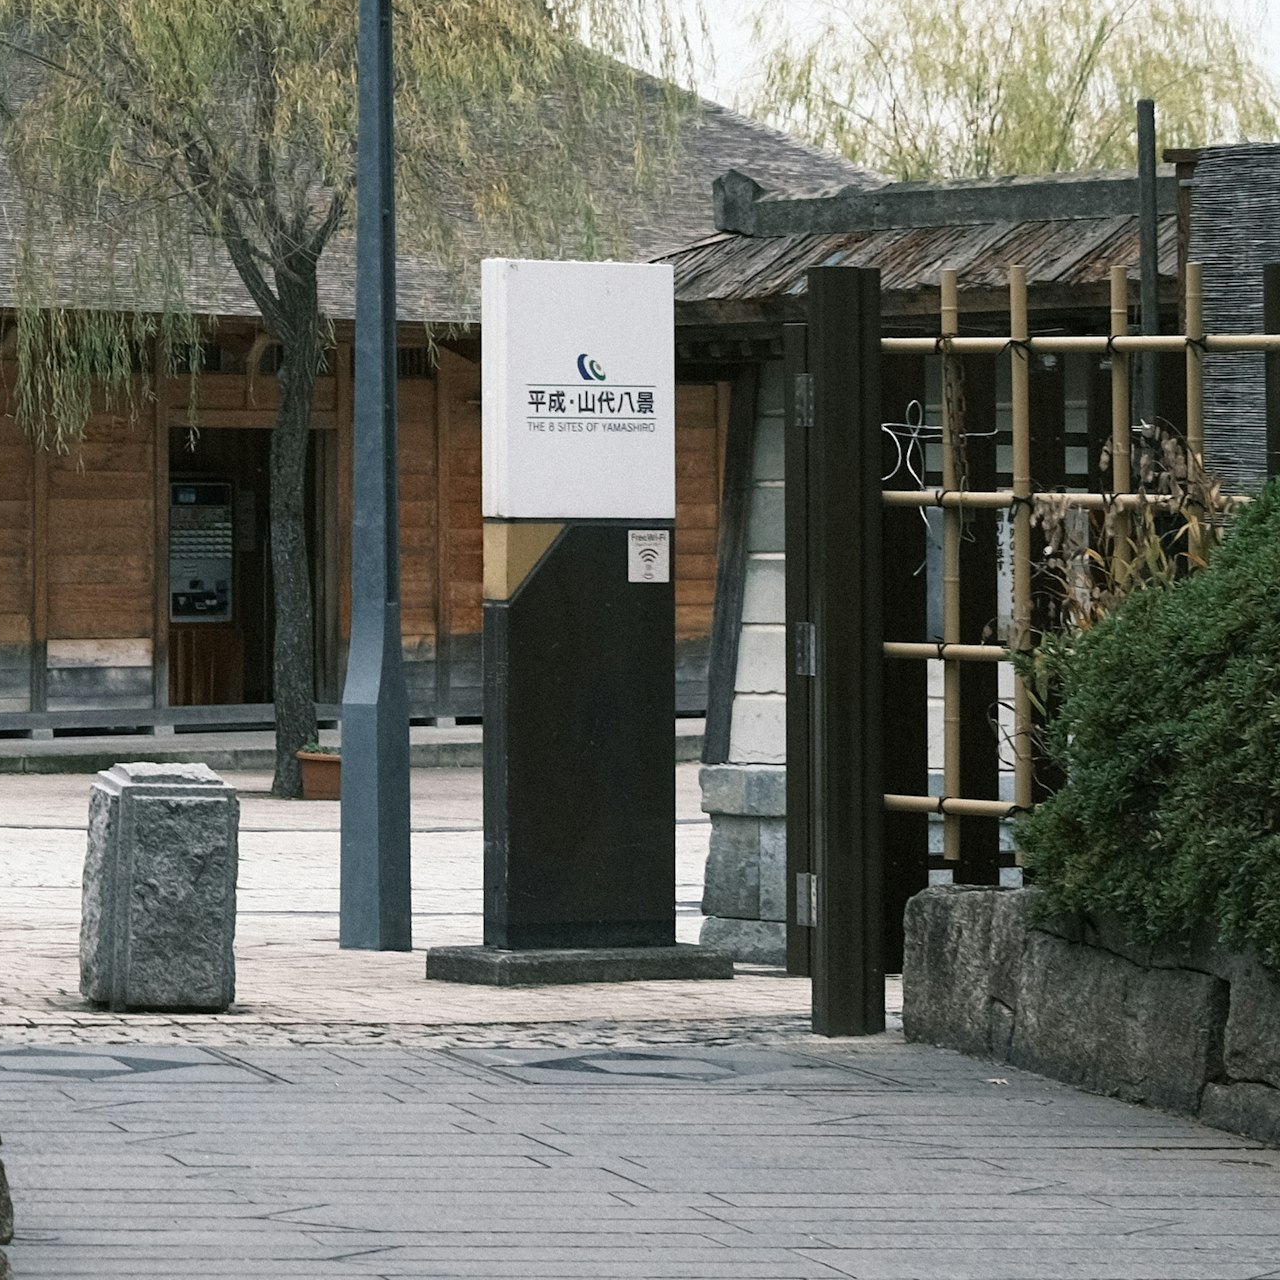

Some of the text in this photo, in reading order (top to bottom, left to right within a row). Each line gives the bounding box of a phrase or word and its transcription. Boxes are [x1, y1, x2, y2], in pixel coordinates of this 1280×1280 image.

[527, 390, 654, 414] 平成・山代八景
[527, 422, 656, 433] THE 8 SITES OF YAMASHIRO
